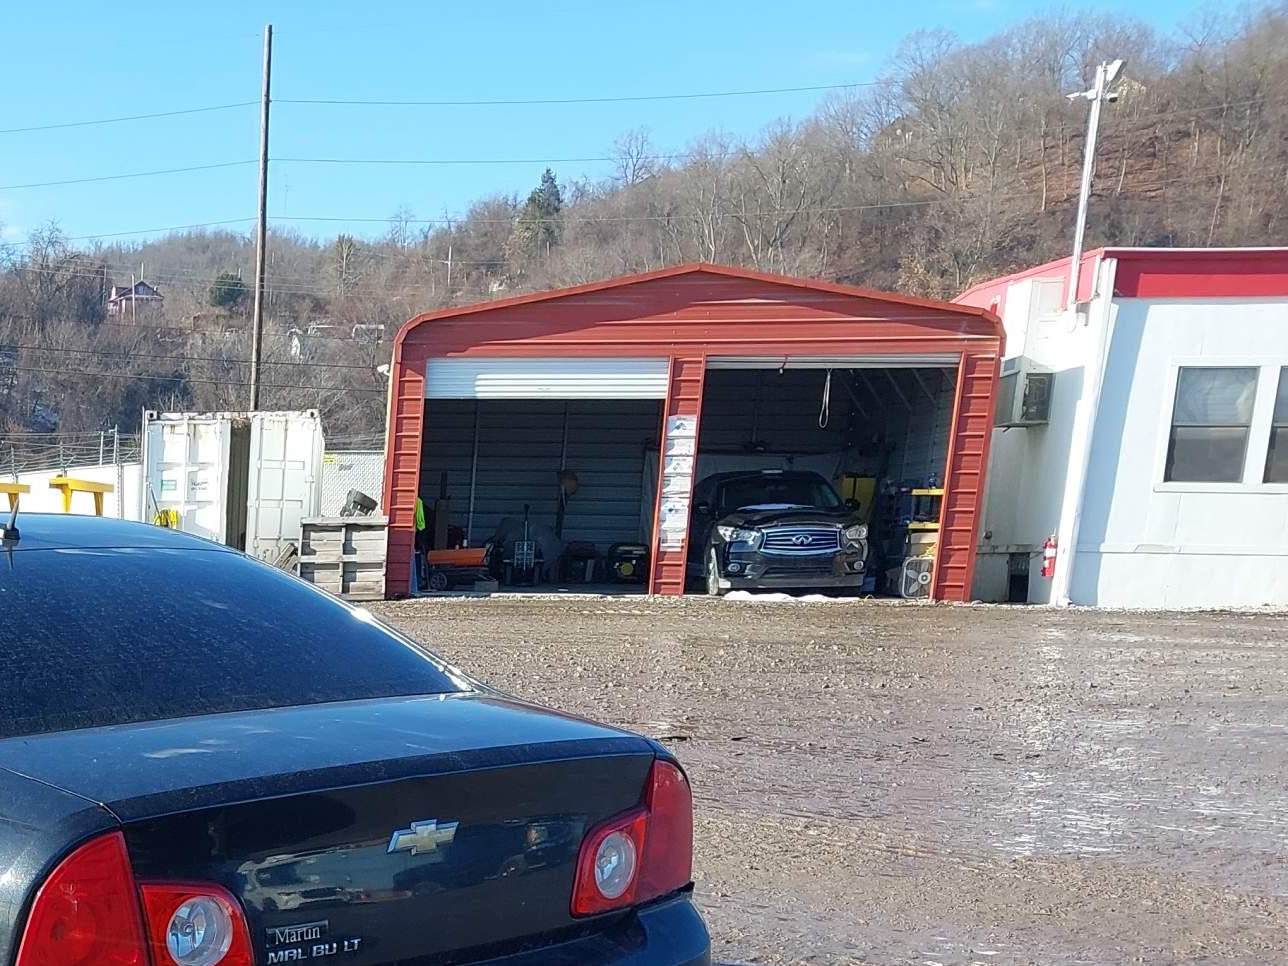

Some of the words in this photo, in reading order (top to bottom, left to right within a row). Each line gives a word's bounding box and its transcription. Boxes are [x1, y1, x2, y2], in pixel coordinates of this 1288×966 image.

[274, 926, 321, 945] Martin
[266, 942, 337, 965] MALBU
[343, 938, 362, 952] LT
